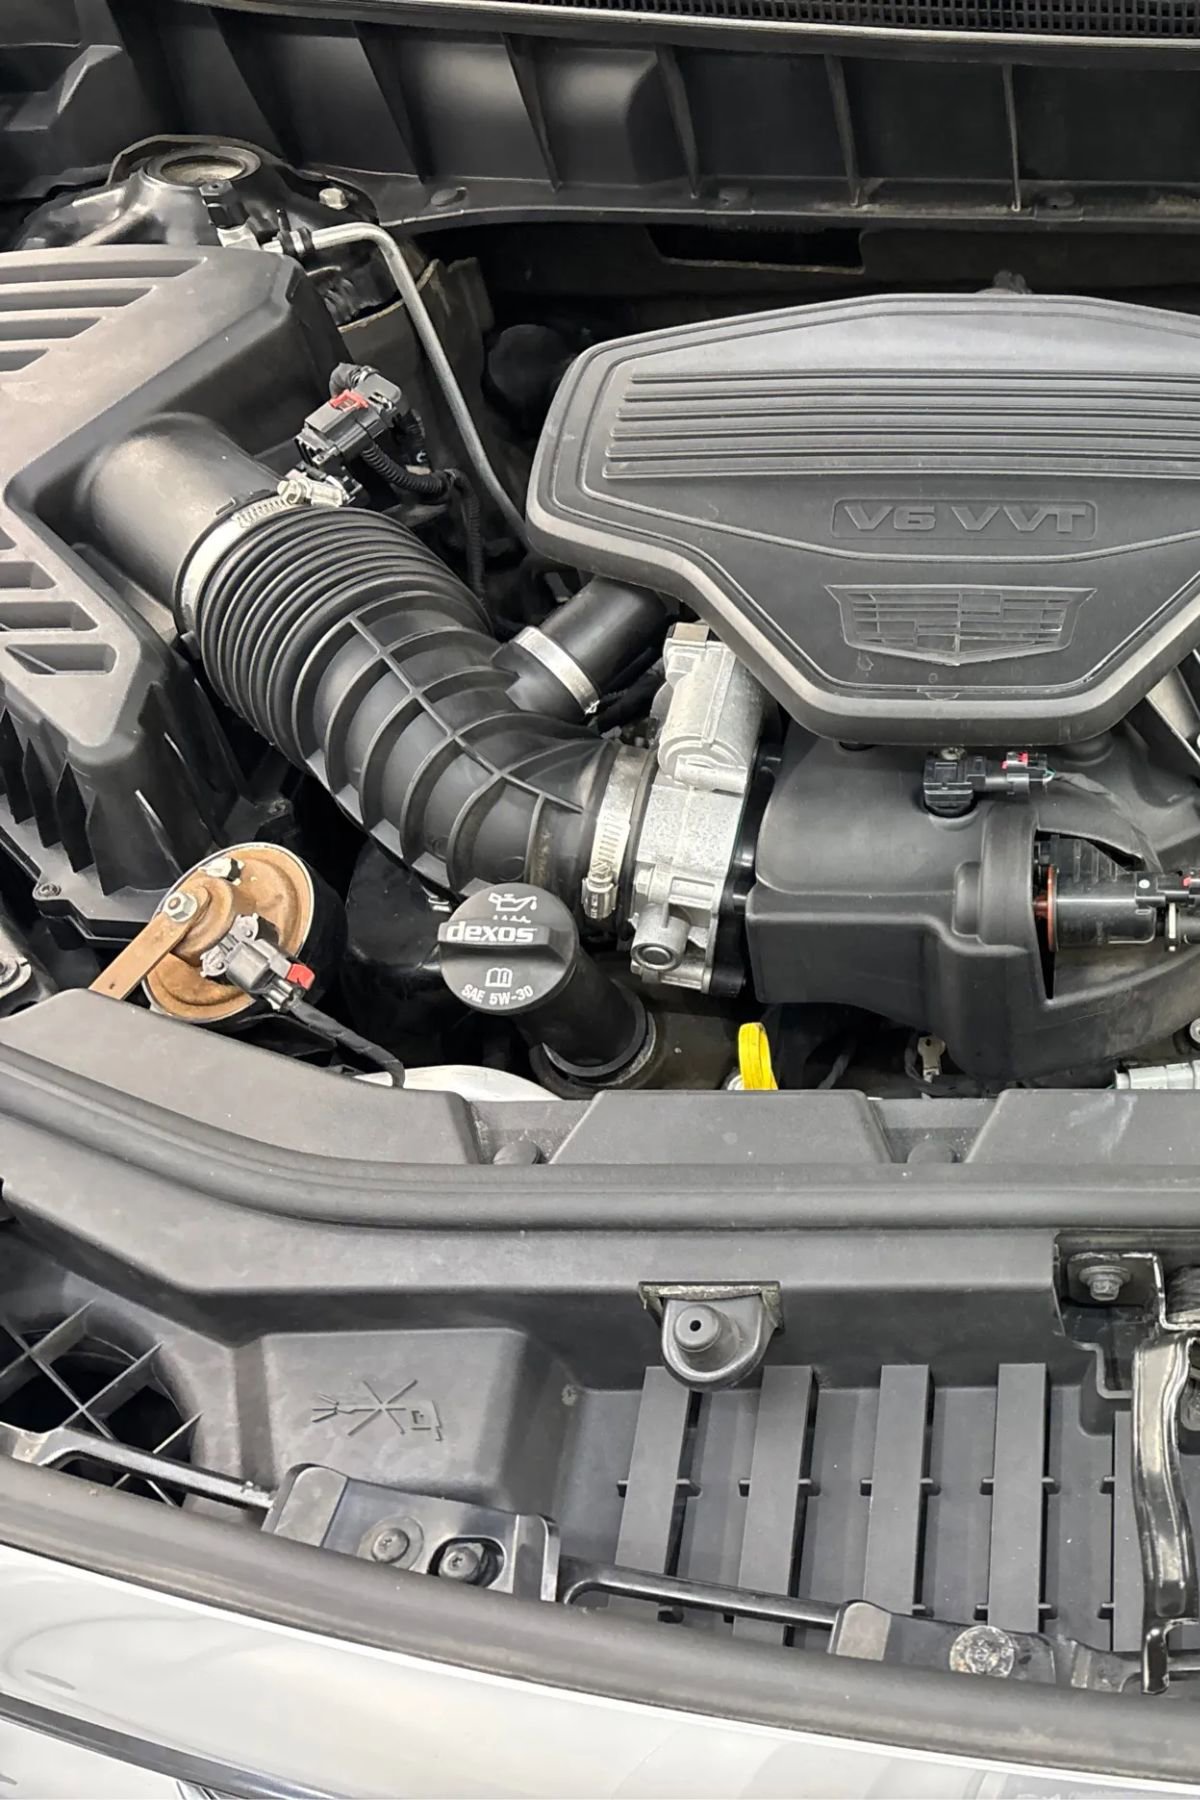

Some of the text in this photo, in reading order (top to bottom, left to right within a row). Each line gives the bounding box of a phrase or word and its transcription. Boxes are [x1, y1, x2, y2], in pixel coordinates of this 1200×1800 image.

[843, 504, 1087, 534] V6 VVT
[446, 921, 538, 943] dexos
[461, 984, 534, 1006] SAE 5W-30
